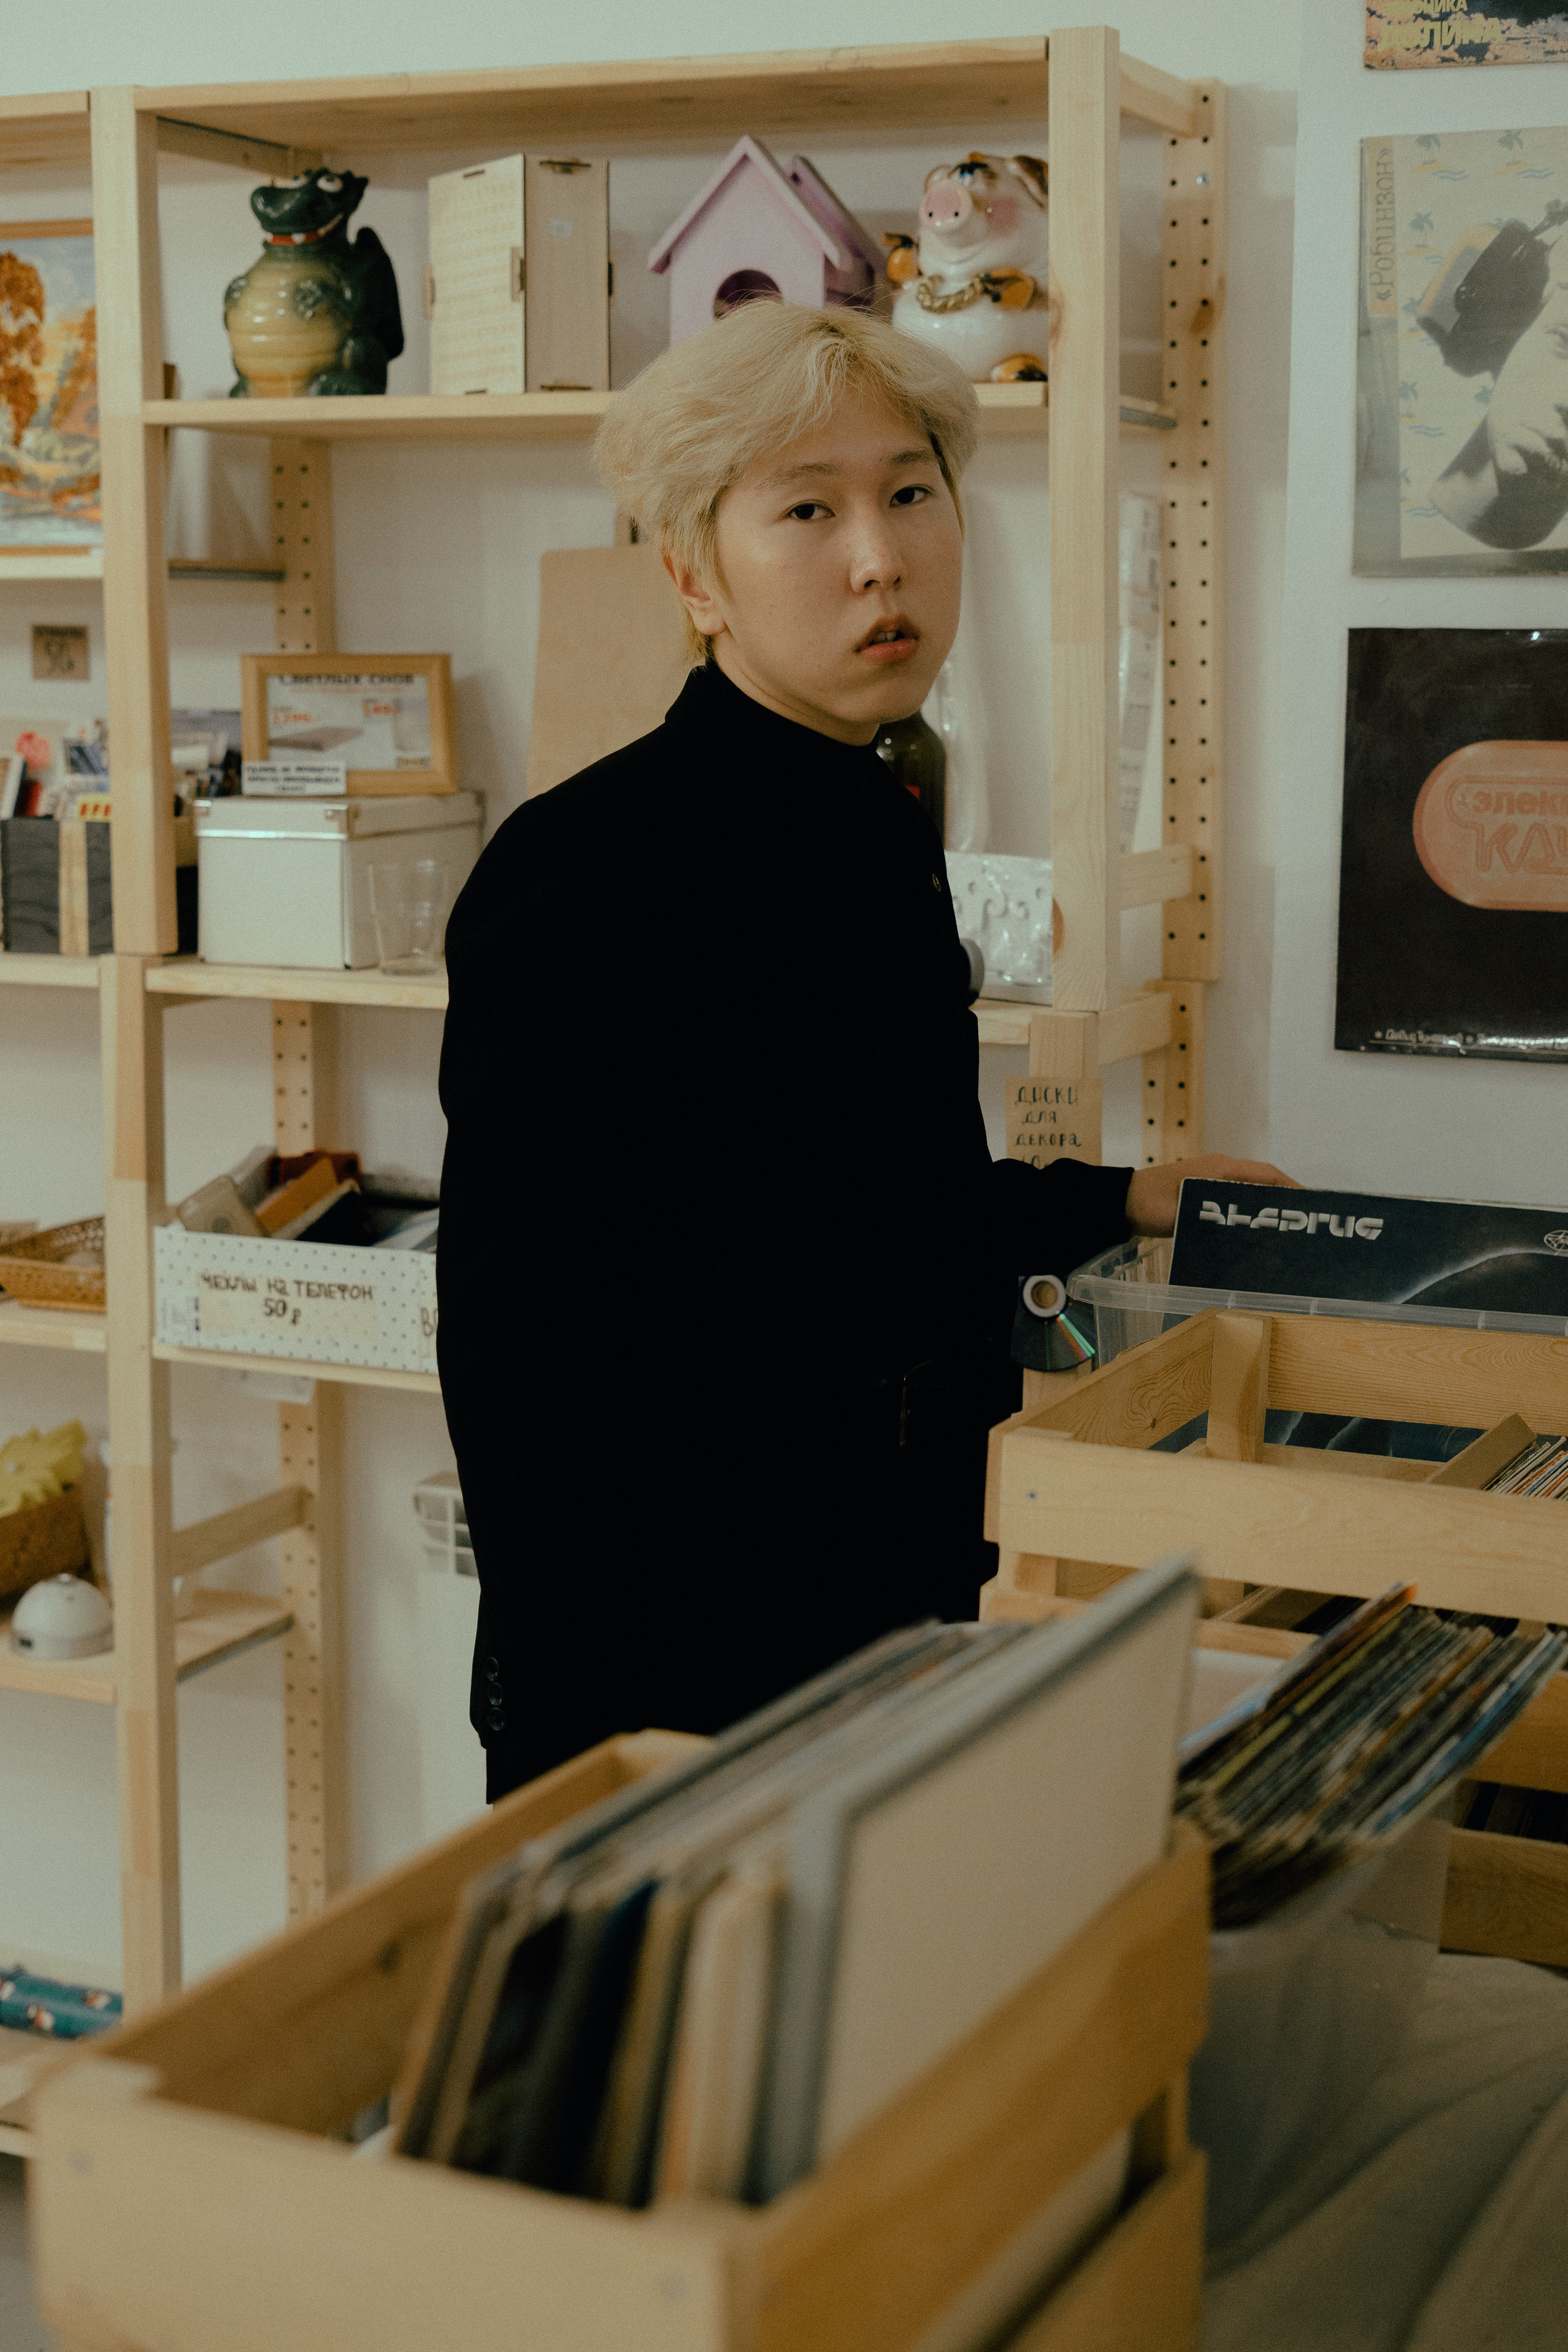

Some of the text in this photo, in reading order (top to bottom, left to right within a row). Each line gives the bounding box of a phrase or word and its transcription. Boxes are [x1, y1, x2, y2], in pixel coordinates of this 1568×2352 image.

[1378, 17, 1504, 51] ДОЛИНА
[1015, 1086, 1078, 1105] ДИСКИ
[1022, 1110, 1057, 1124] ДЛЯ
[201, 1272, 257, 1292] ЧЕХЛЫ
[293, 1279, 374, 1301] ТЕЛЕФОН
[263, 1297, 287, 1317] 50
